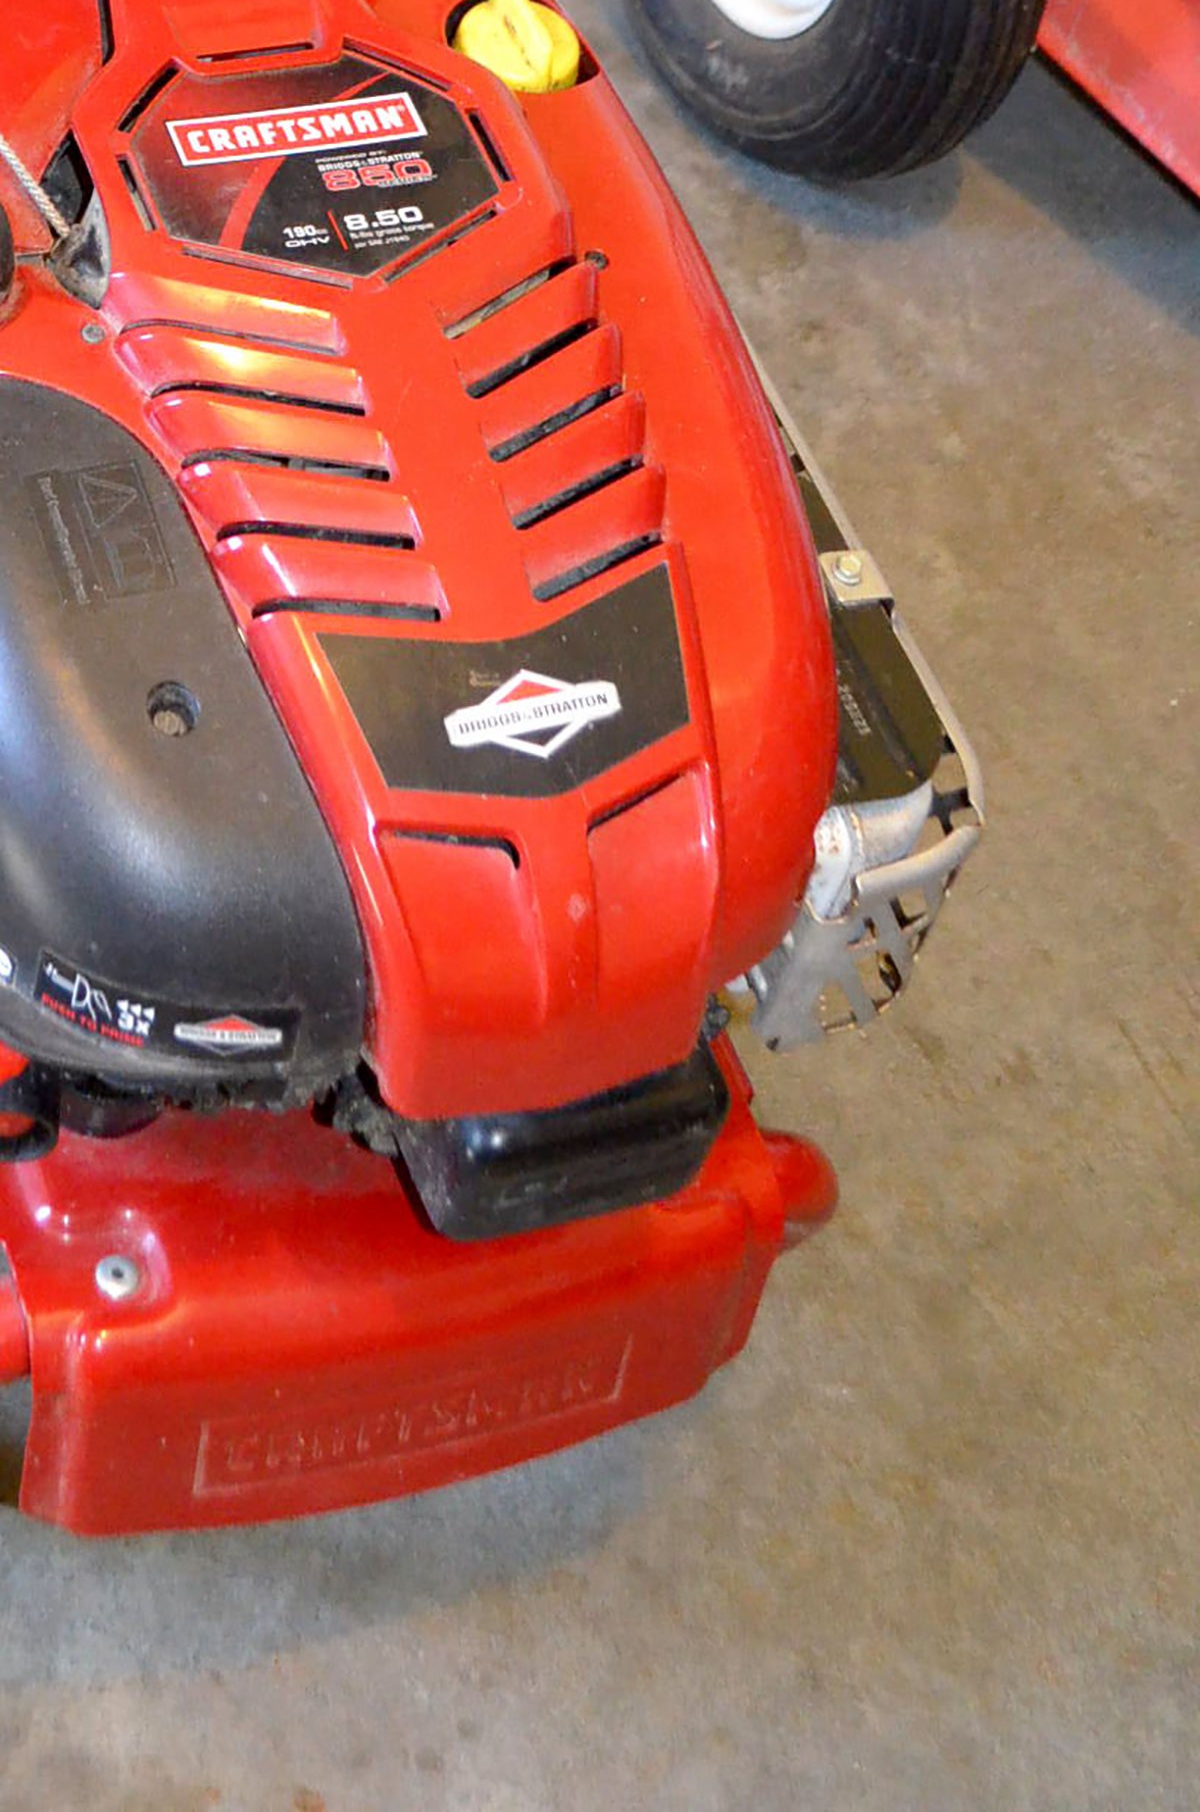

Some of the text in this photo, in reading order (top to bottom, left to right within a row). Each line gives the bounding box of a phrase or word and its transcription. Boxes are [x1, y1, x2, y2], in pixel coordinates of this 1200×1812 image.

[187, 104, 404, 154] CRAFTSMAN
[322, 158, 433, 192] 850
[343, 206, 424, 231] 8.50
[285, 235, 330, 248] OHV
